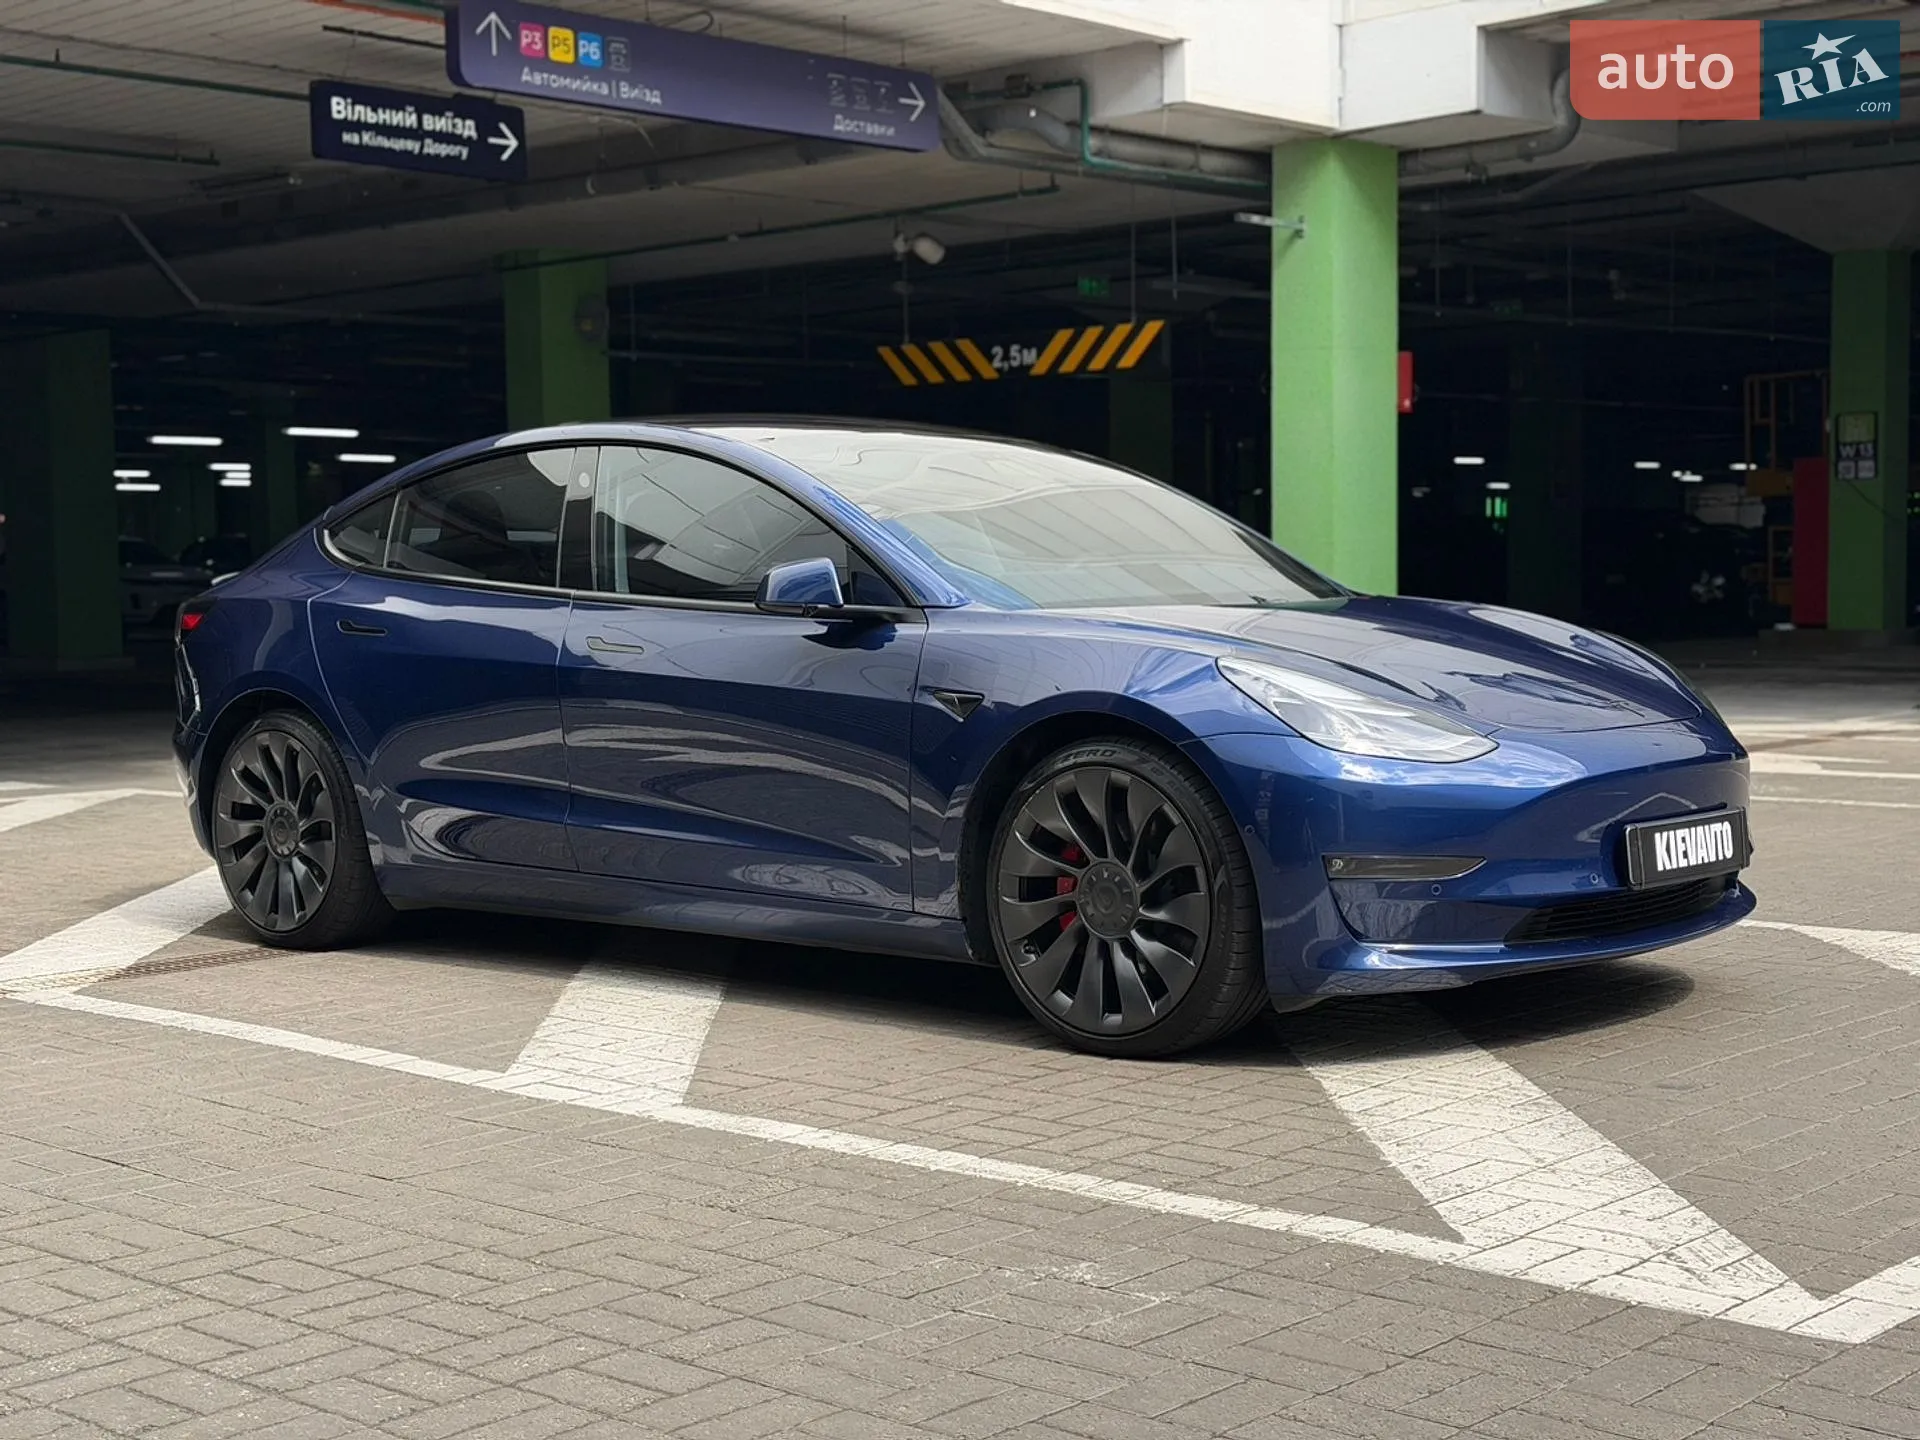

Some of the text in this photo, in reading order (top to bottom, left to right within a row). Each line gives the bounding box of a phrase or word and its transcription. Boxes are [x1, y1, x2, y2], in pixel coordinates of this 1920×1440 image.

[521, 66, 609, 95] Автомийка
[330, 95, 478, 141] Вільний виїзд
[341, 130, 469, 160] на Кільцеву Дорогу
